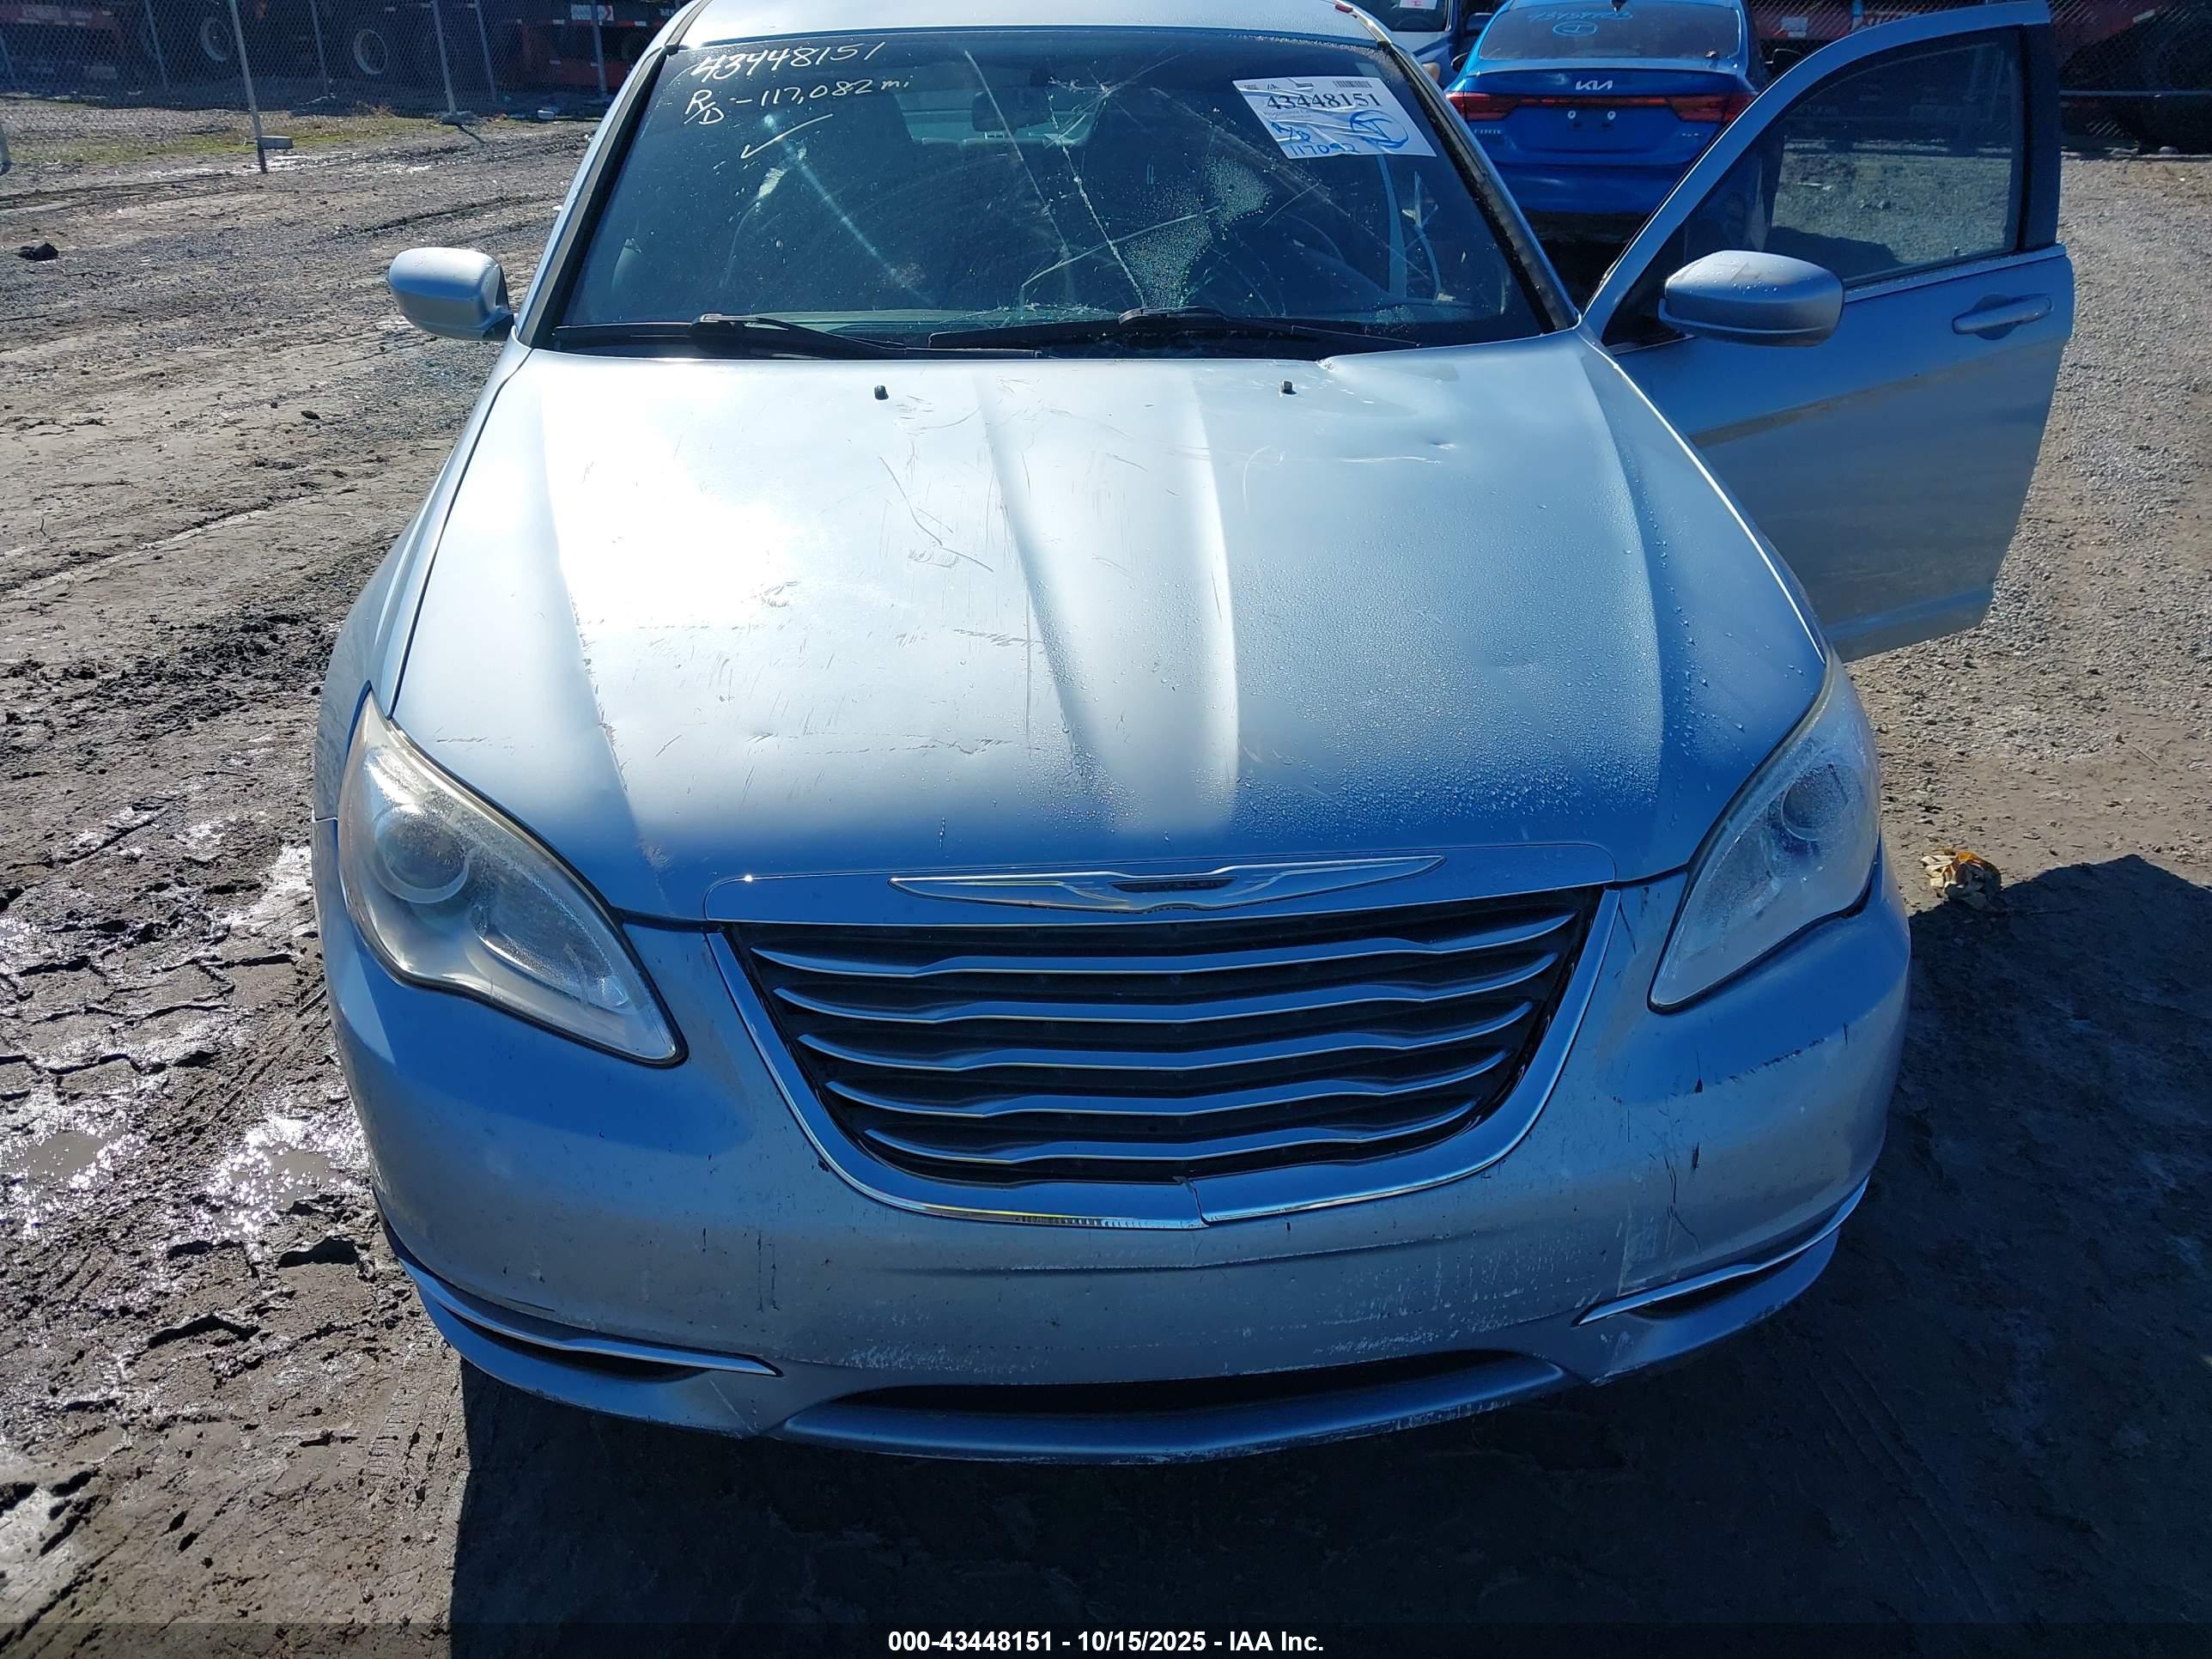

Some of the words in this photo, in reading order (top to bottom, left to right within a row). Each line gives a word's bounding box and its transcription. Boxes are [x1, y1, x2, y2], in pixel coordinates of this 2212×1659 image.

[690, 41, 886, 83] 43448151
[760, 79, 872, 106] 117,082
[1575, 80, 1613, 90] KIA
[1267, 92, 1382, 110] 43448151
